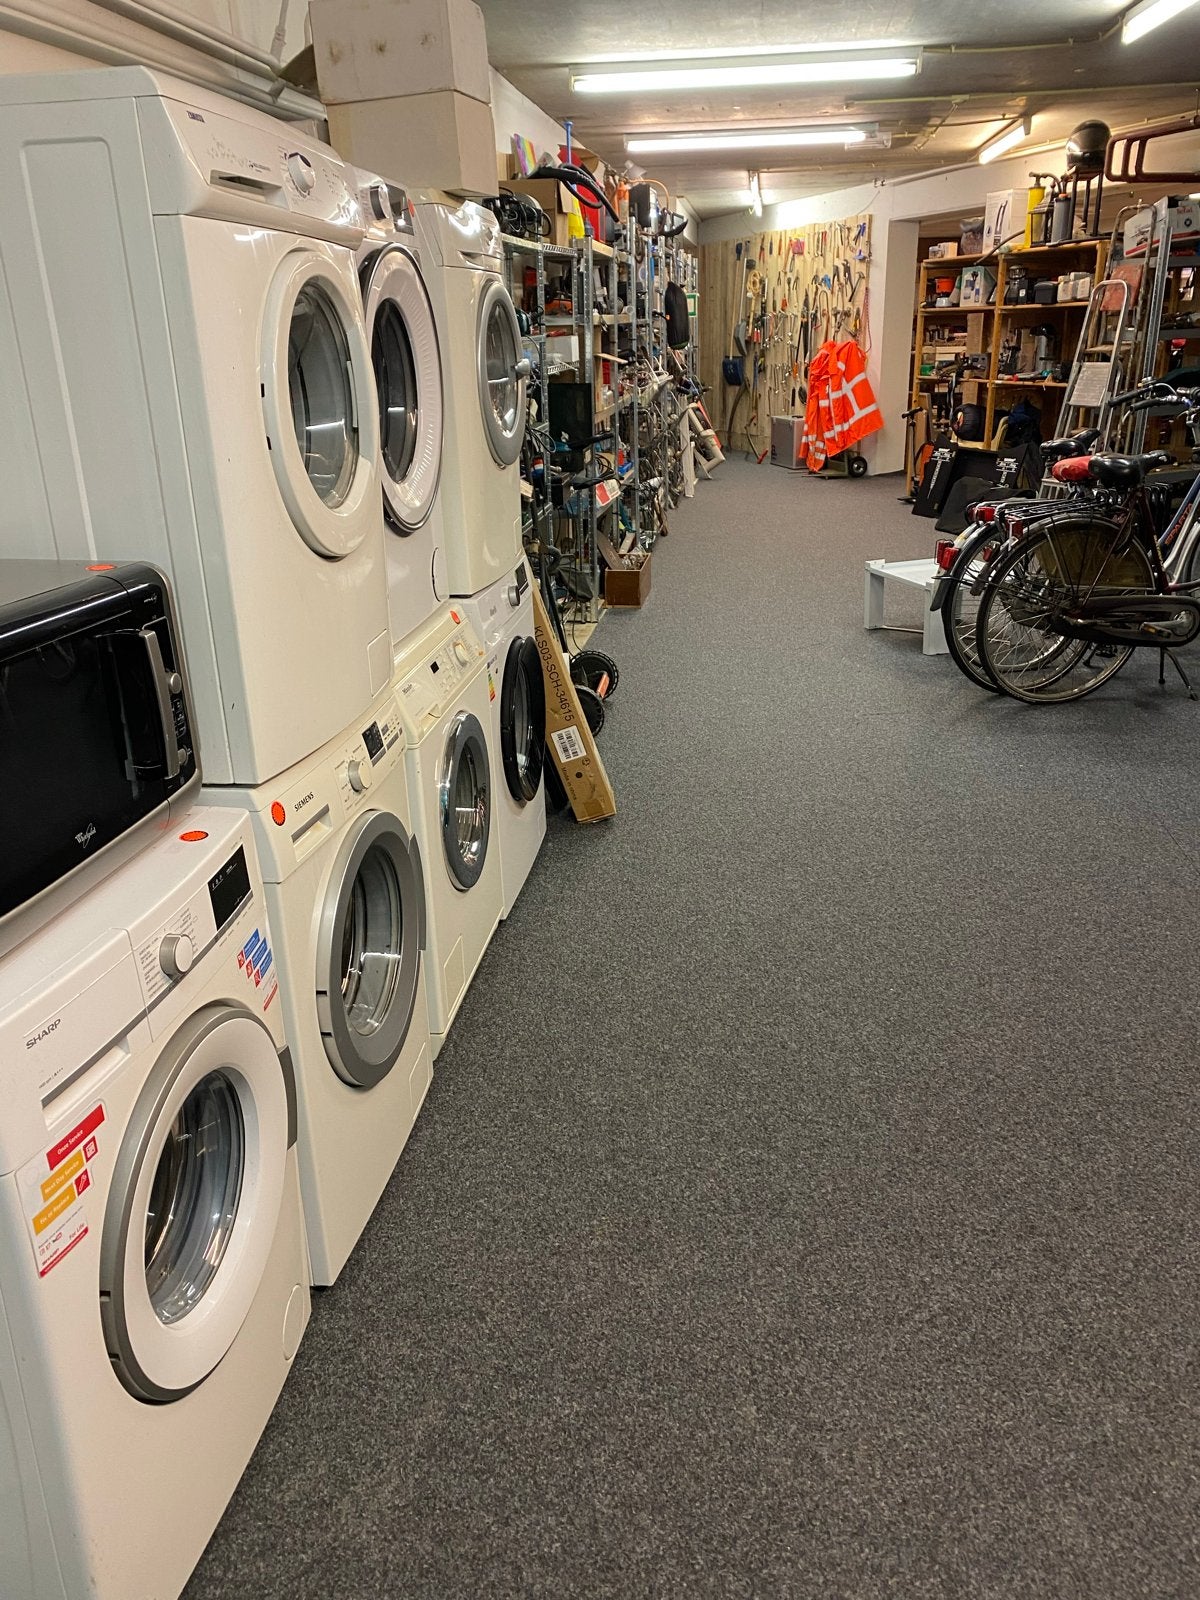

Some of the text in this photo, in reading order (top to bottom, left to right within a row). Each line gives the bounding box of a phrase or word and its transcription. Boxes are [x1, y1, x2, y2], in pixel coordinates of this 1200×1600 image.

[534, 626, 575, 722] KLS03-SCH-34615
[294, 791, 314, 812] SIEMENS
[26, 1018, 61, 1050] SHARP
[68, 1127, 83, 1145] Service
[64, 1158, 79, 1176] Service
